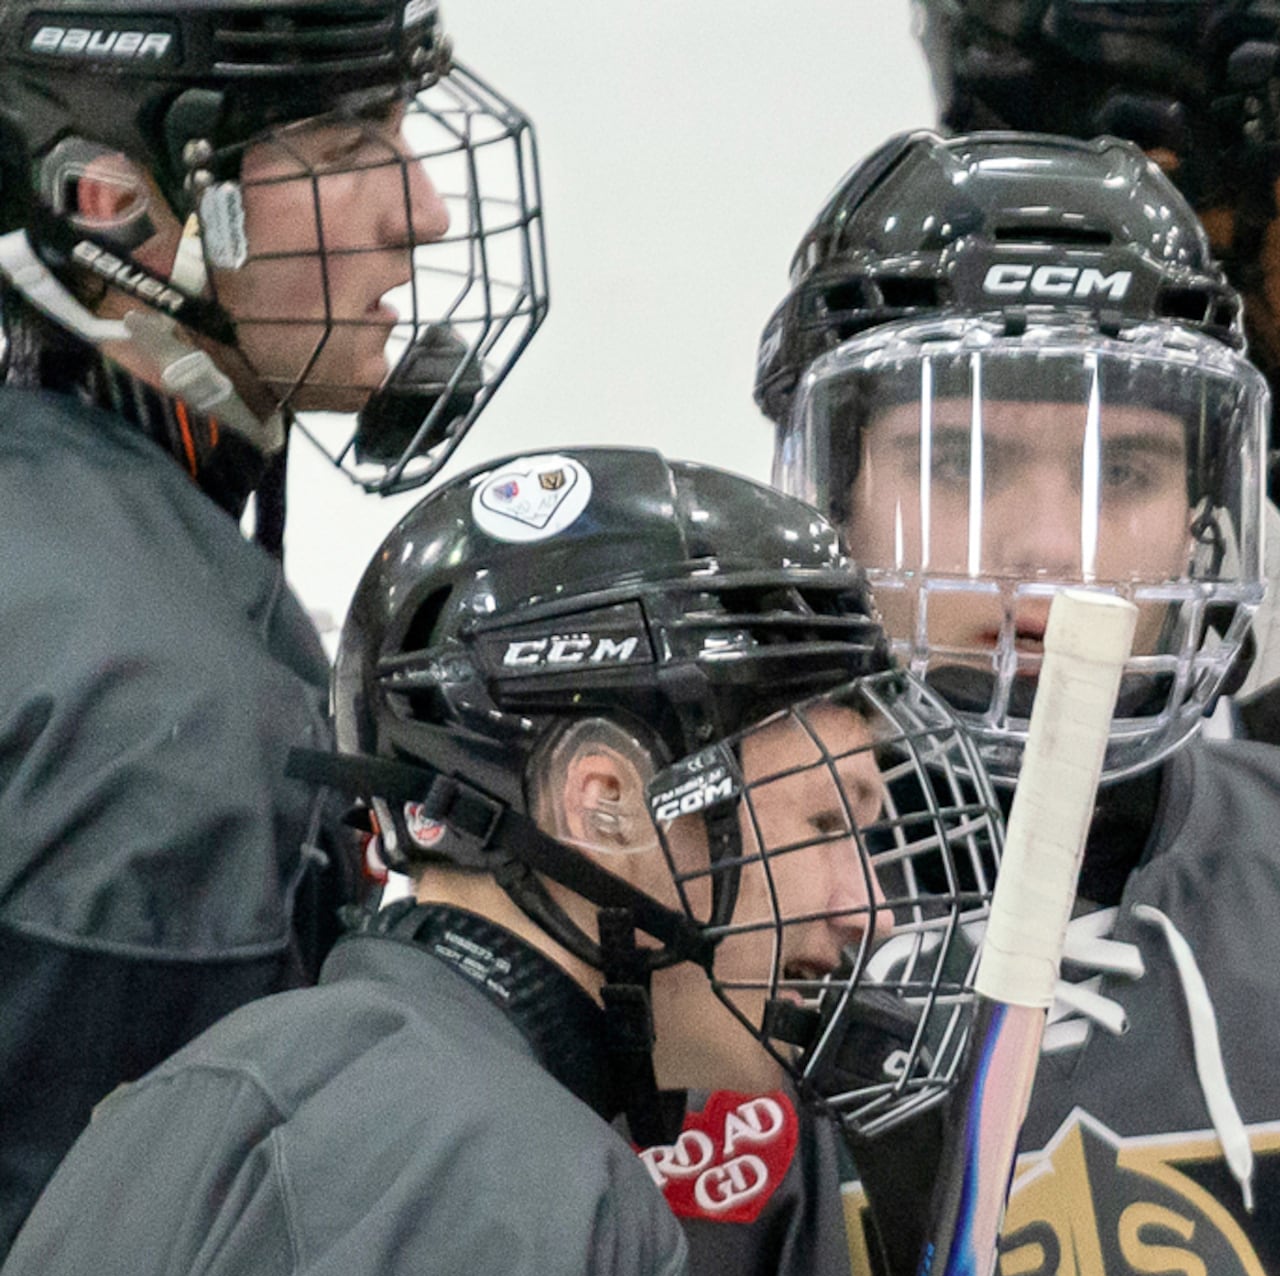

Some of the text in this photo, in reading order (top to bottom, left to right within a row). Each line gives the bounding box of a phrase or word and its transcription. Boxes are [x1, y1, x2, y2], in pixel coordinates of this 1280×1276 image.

[31, 27, 172, 58] BAUER
[73, 240, 184, 312] BAUER
[982, 264, 1132, 301] CCM
[503, 635, 638, 666] CCM
[694, 1154, 768, 1211] GD
